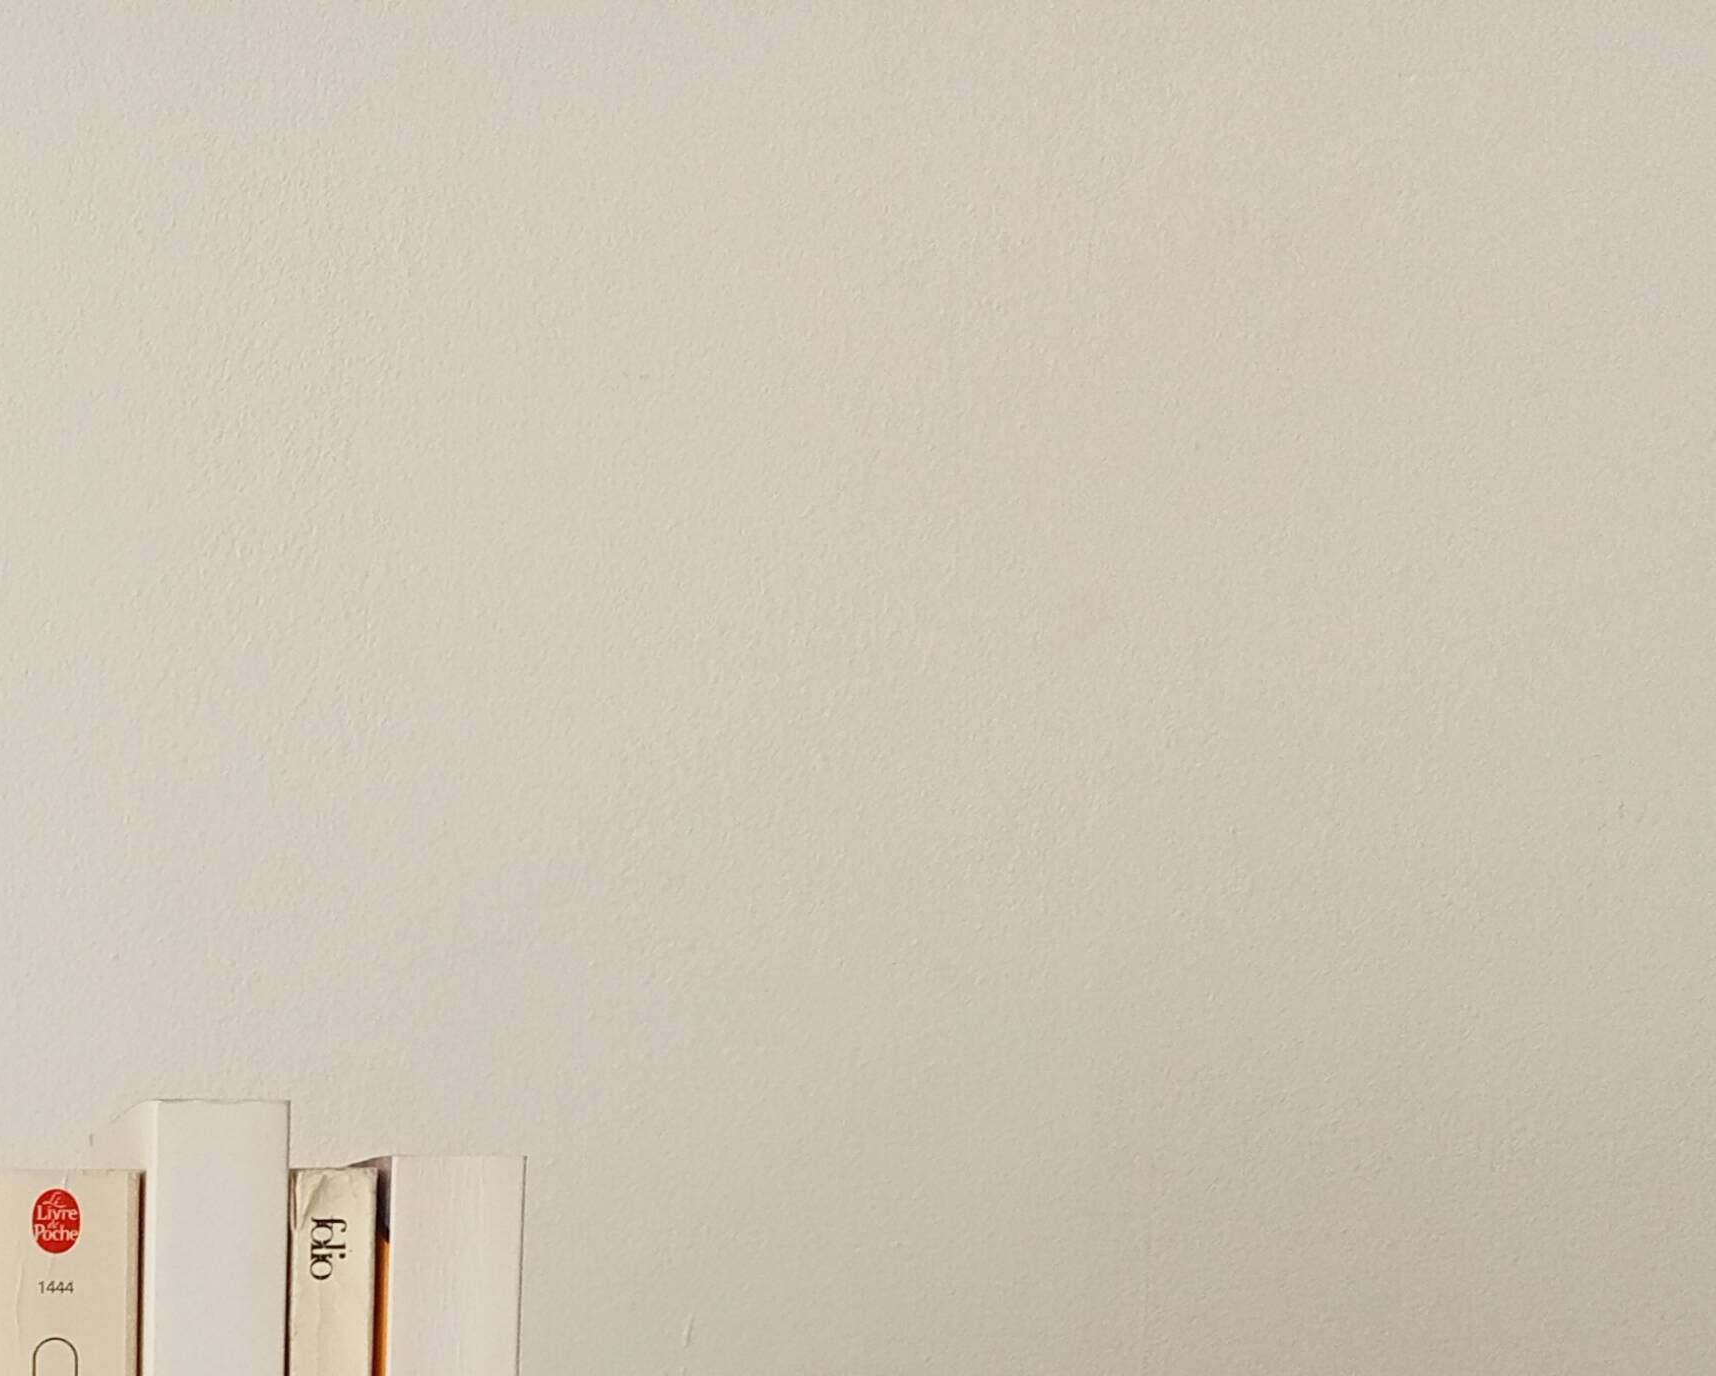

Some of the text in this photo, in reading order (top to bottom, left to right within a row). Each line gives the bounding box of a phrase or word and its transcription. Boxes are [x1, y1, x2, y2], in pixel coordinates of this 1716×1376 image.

[36, 1205, 78, 1221] Livre
[34, 1223, 78, 1242] Poche
[309, 1218, 347, 1279] folio
[38, 1281, 75, 1294] 1444
